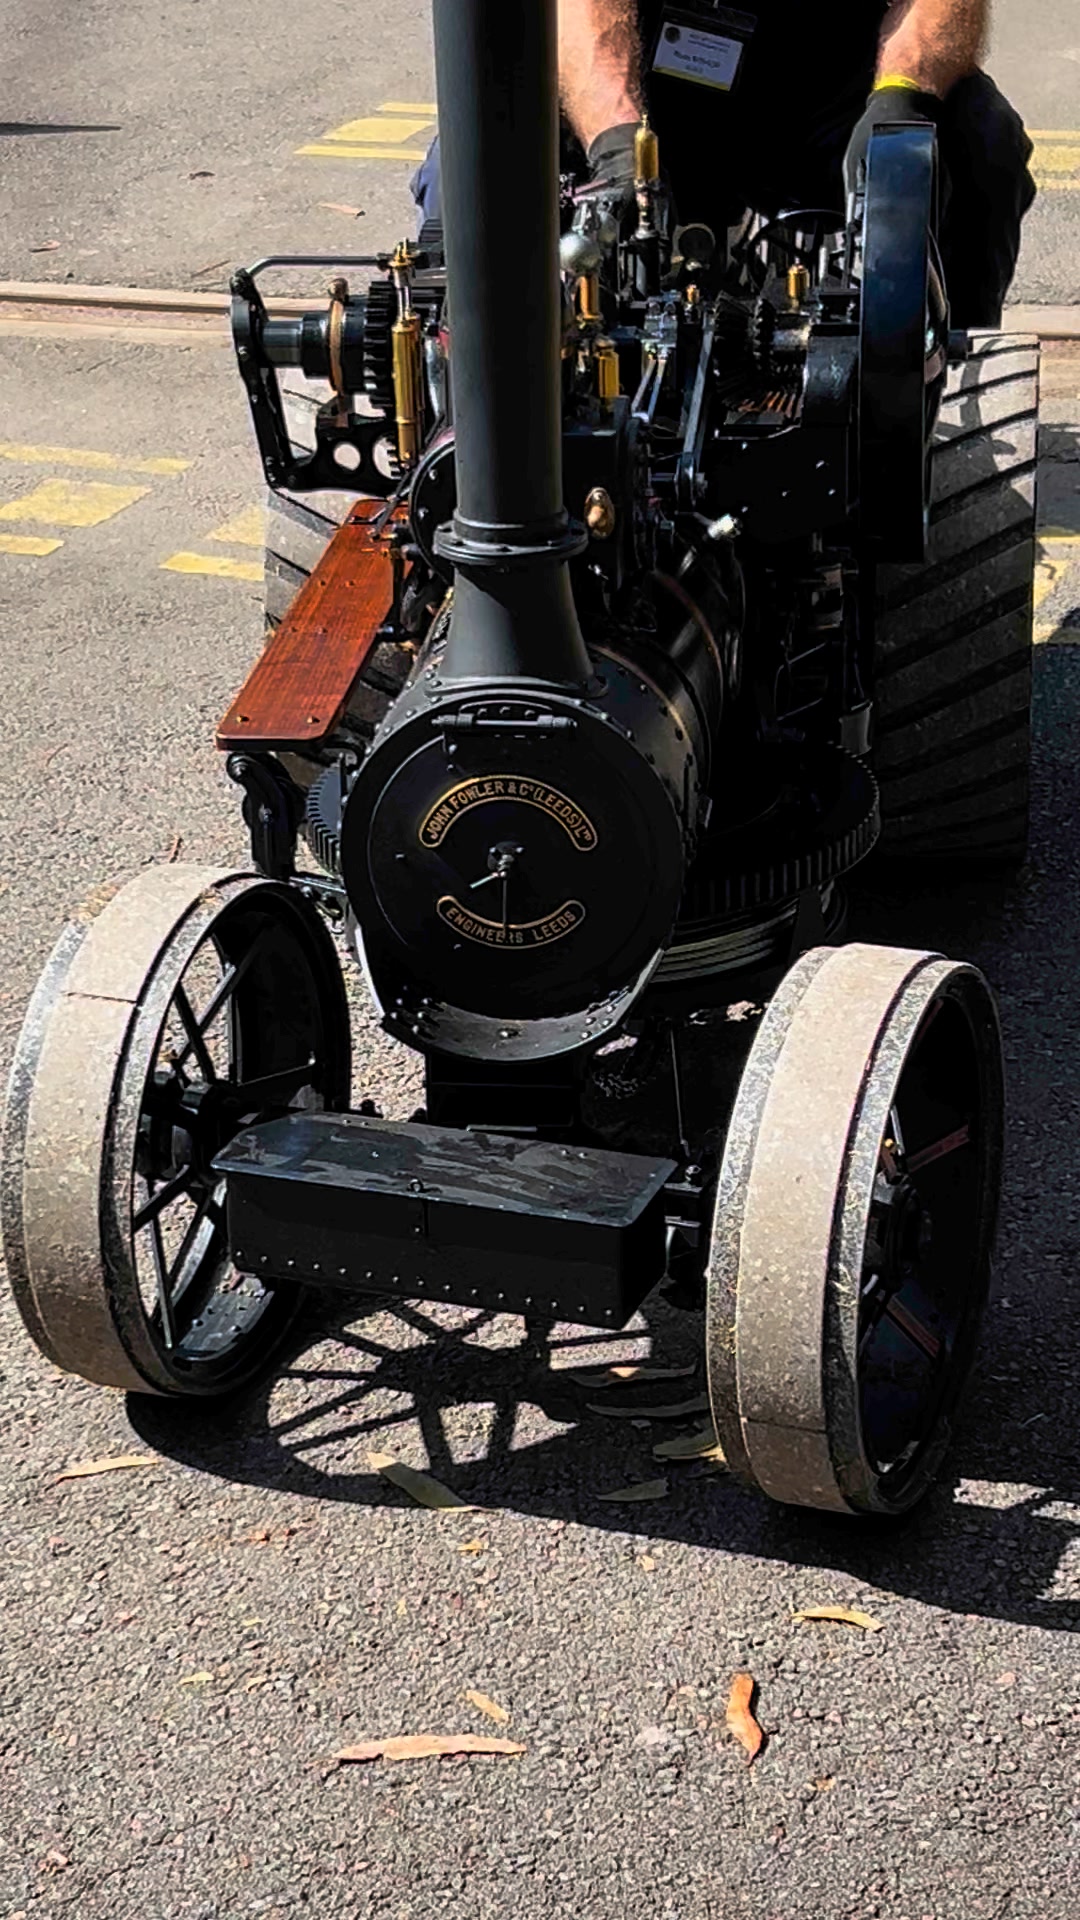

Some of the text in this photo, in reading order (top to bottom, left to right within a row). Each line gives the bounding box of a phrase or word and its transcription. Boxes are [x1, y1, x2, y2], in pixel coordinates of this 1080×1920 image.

[426, 804, 454, 840] JOHN
[448, 781, 505, 810] FOWLER
[507, 781, 517, 794] &
[533, 787, 583, 829] (LEEDS)
[532, 910, 577, 941] LEEDS
